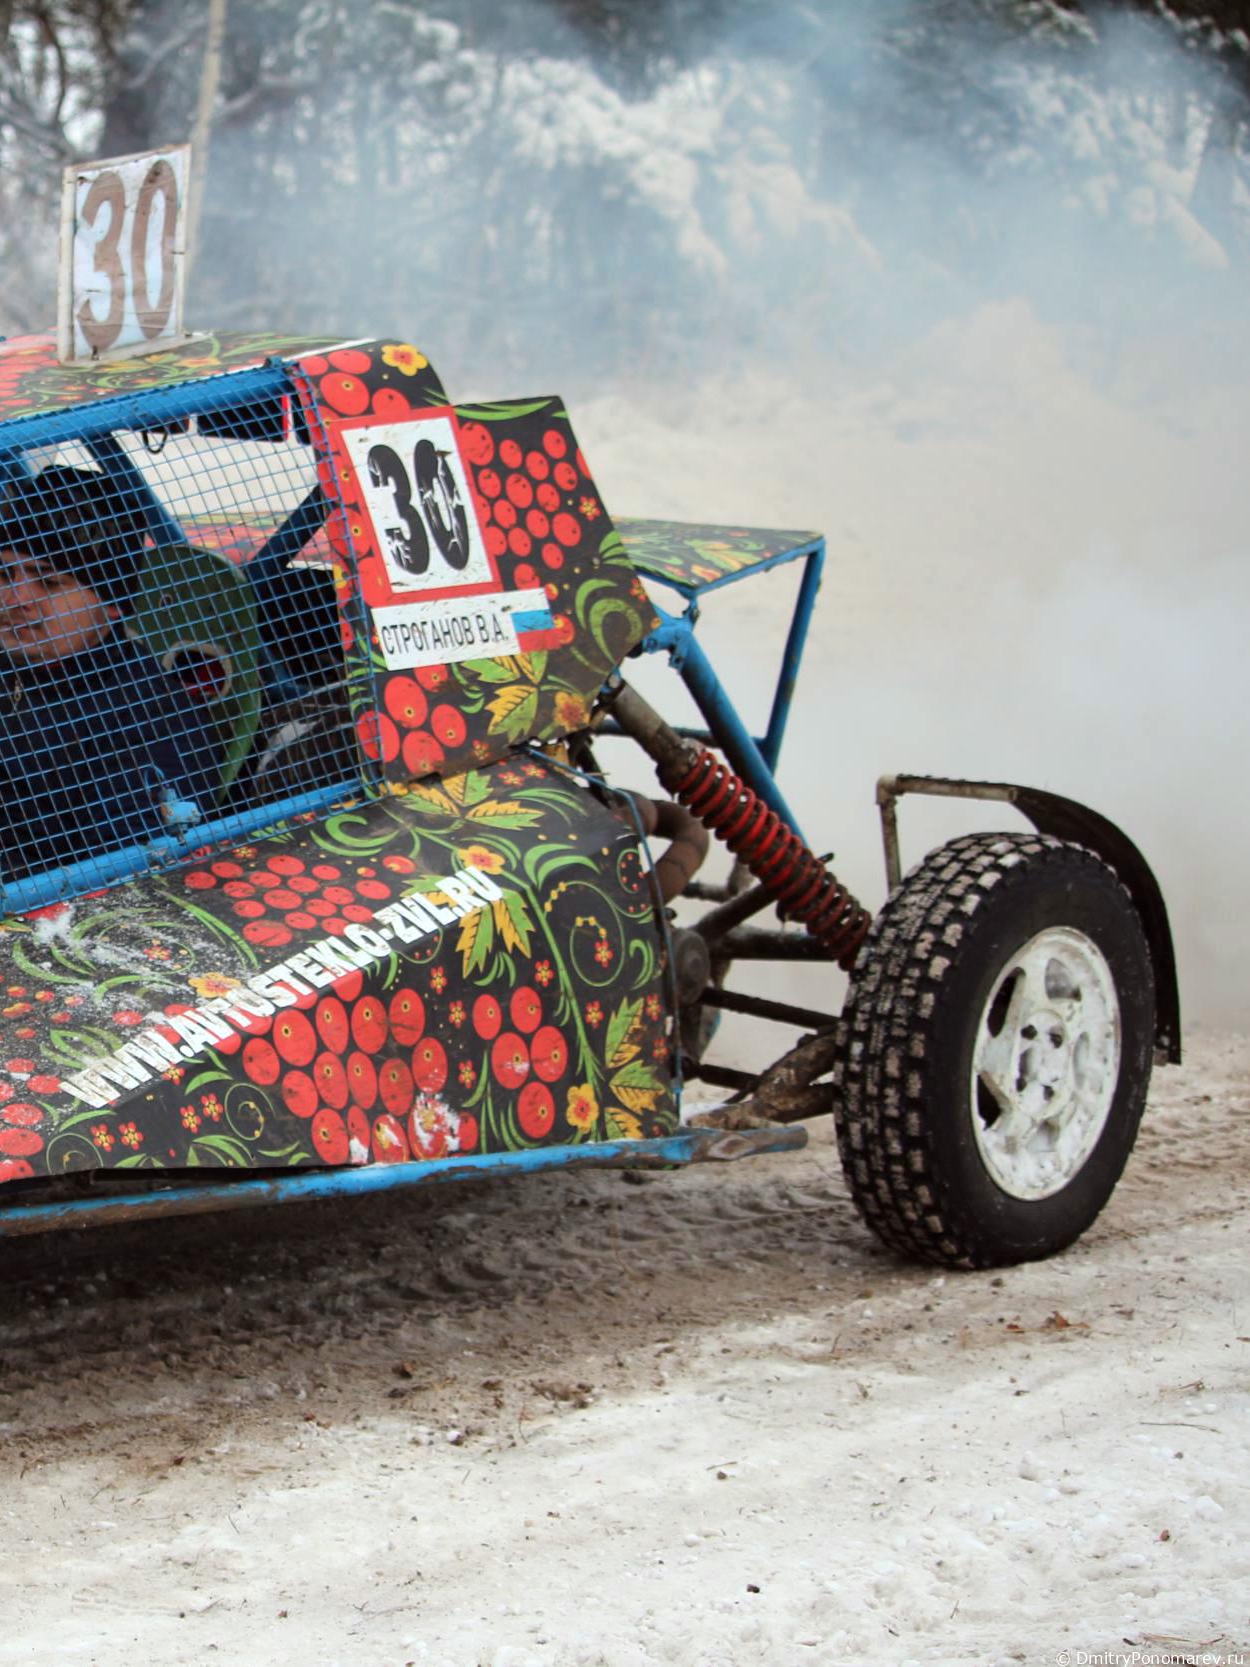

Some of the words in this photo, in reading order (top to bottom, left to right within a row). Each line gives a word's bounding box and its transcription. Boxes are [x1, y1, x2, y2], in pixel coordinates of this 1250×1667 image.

[77, 160, 177, 350] 30
[367, 439, 470, 575] 30
[381, 616, 475, 655] СТРОГАНОВ
